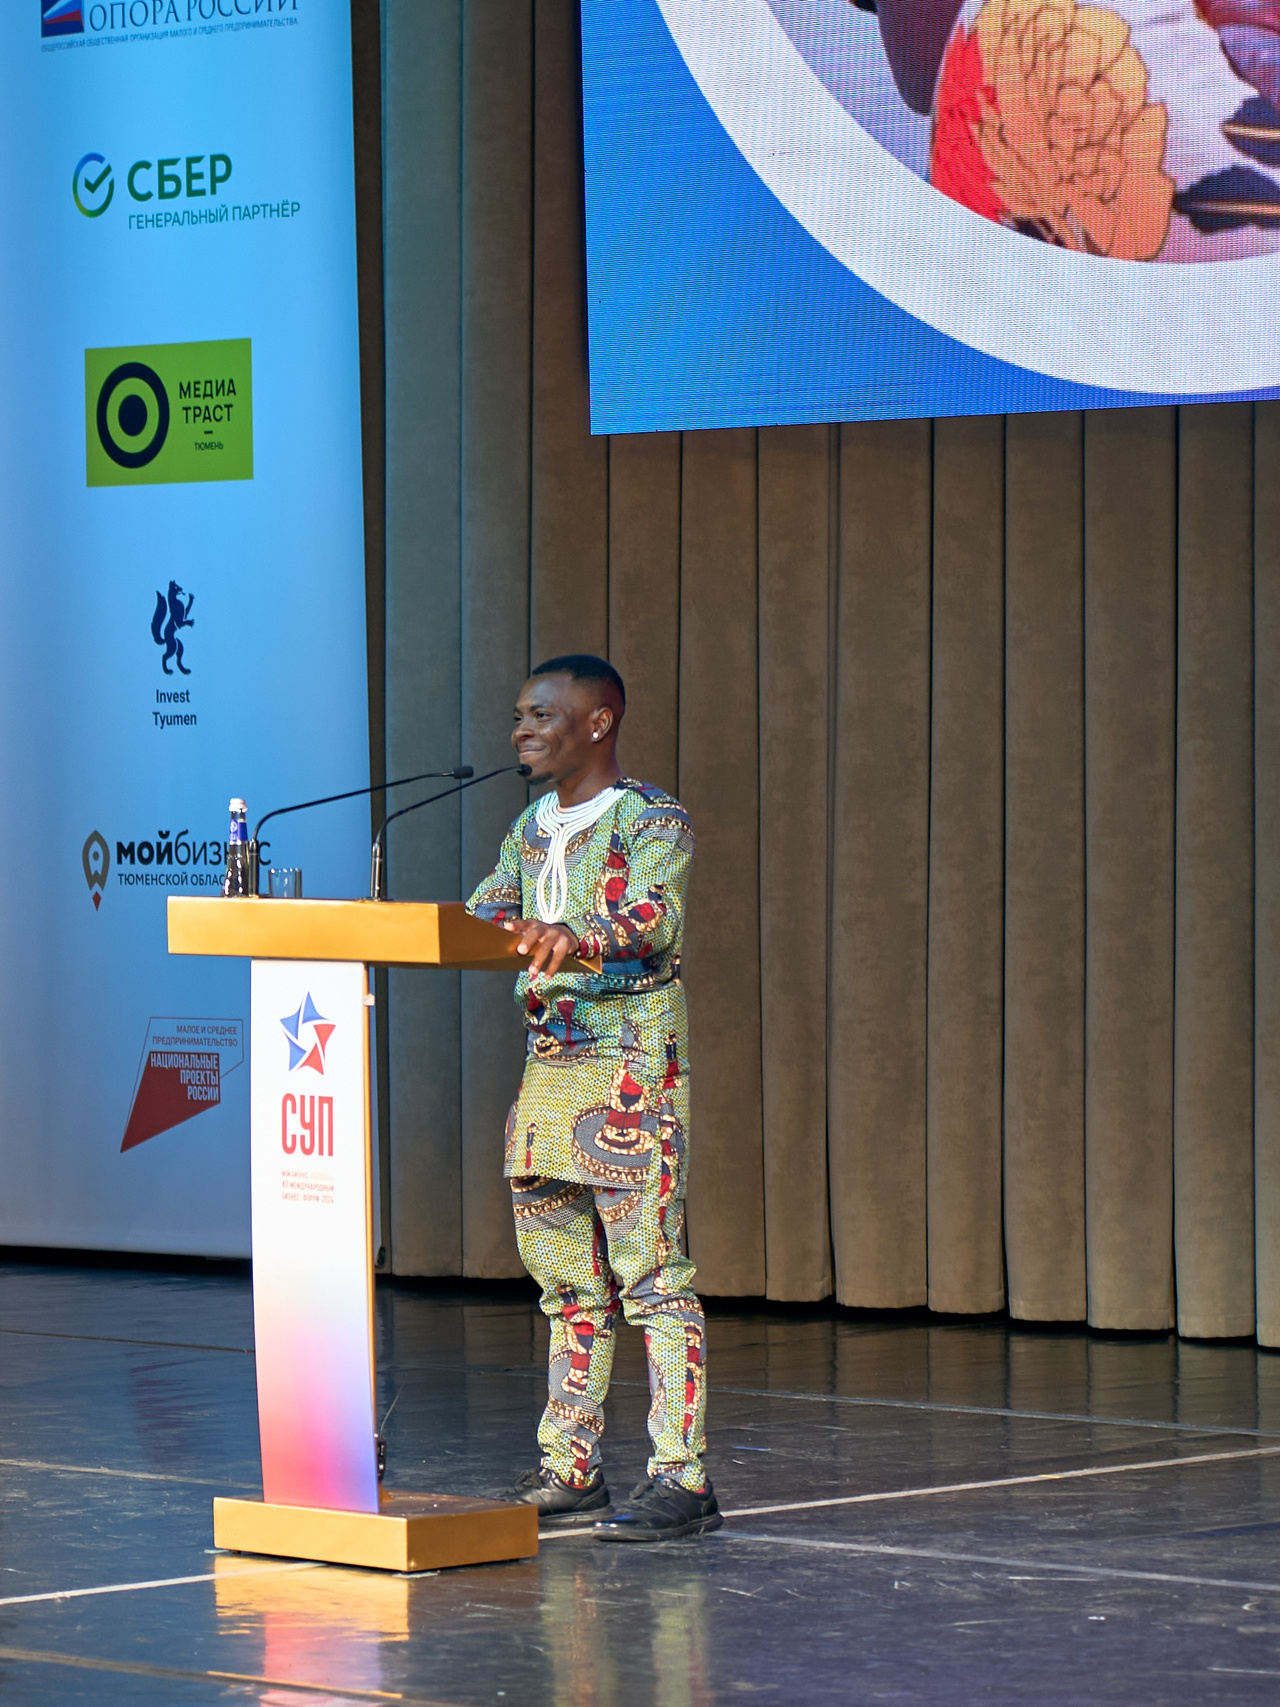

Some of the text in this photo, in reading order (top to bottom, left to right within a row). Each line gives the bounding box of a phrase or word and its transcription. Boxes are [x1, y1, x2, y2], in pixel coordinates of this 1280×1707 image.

[89, 0, 181, 31] ОПОРА
[129, 30, 169, 43] ОРГАНИЗАЦИЯ
[224, 17, 298, 33] ПРЕДПРИНИМАТЕЛЬСТВА
[127, 153, 232, 202] СБЕР
[128, 200, 301, 230] ГЕНЕРАЛЬНЫЙ ПАРТНЁР
[179, 378, 236, 399] МЕДИА
[182, 404, 234, 424] ТРАСТ
[194, 441, 224, 451] ТЮМЕНЬ
[156, 689, 190, 703] Invest
[152, 711, 197, 730] Tyumen
[118, 872, 227, 886] ТЮМЕНСКОЙ ОБЛАС
[176, 1025, 237, 1035] МАЛОЕ И СРЕДНЕЕ
[152, 1036, 238, 1047] ПРЕДПРИНИМАТЕЛЬСТВО
[150, 1052, 218, 1069] НАЦИОНАЛЬНЫЕ
[180, 1069, 219, 1085] ПРОЕКТЫ
[187, 1086, 219, 1101] РОССИИ
[281, 1093, 334, 1157] СУП
